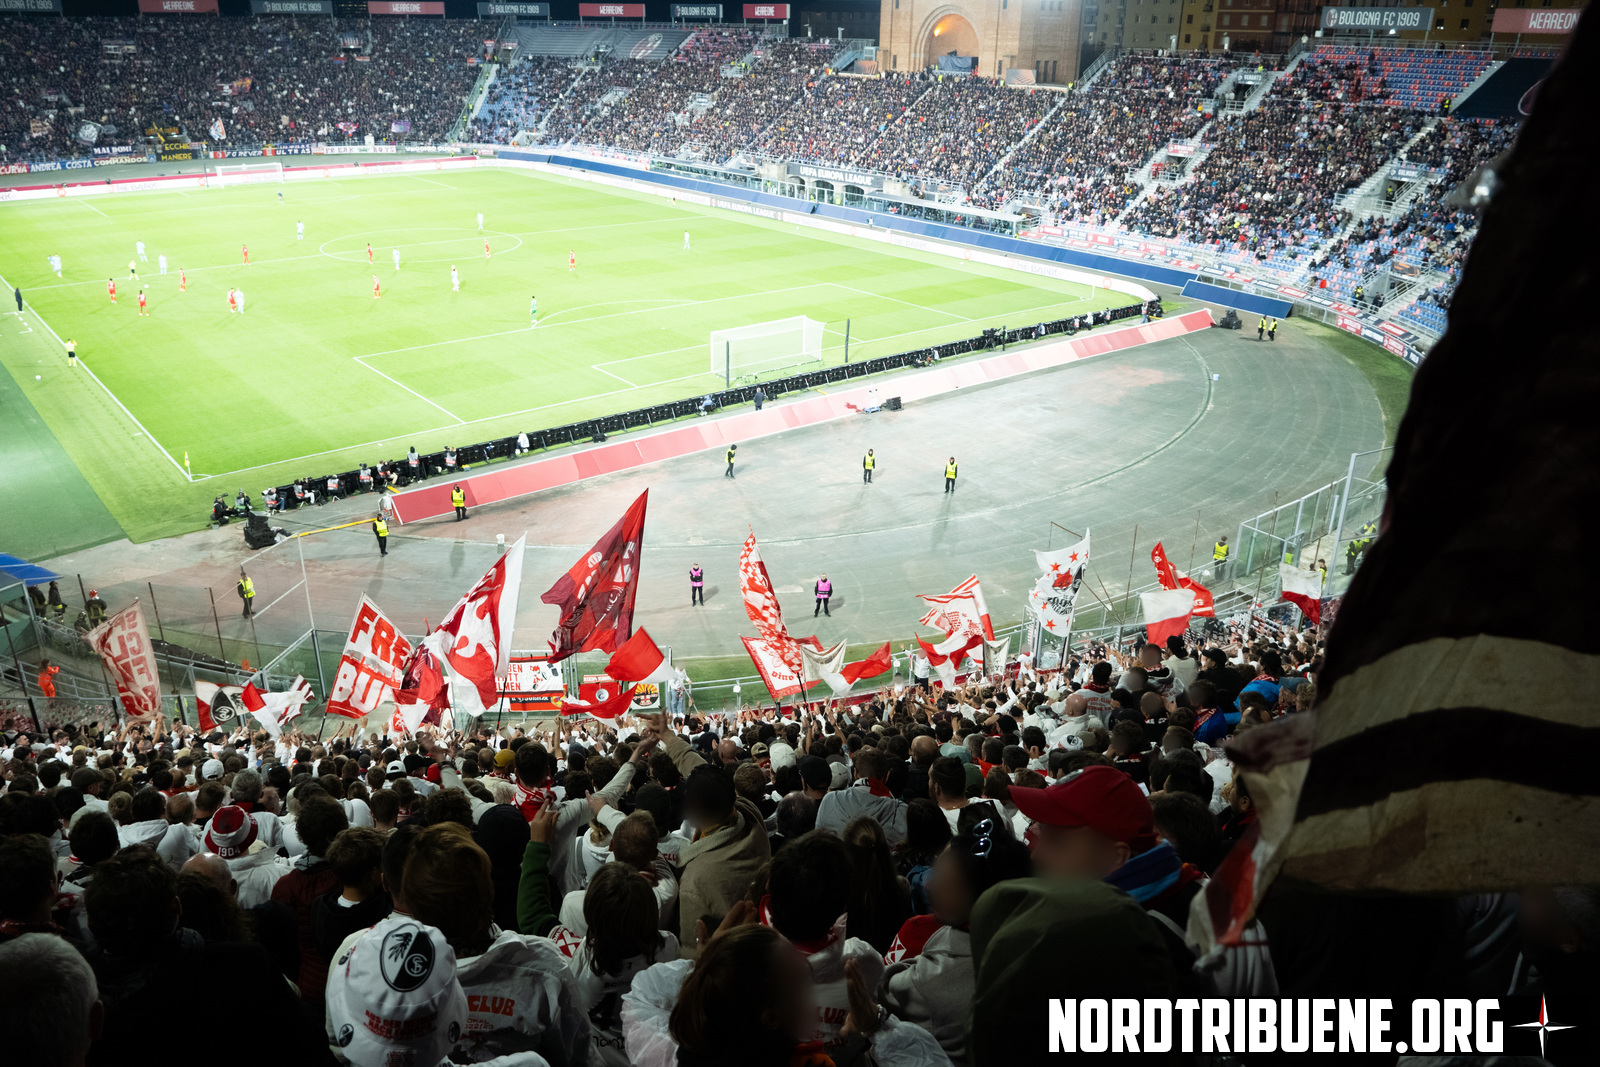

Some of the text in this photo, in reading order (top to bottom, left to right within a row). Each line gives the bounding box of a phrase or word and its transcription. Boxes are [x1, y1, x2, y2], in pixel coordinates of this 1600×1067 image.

[163, 1, 195, 10] WEAREONE
[272, 3, 322, 12] BOLOGNA FC 1909
[392, 3, 421, 12] WEAREONE
[495, 4, 540, 14] BOLOGNA FC 1909
[600, 5, 624, 15] WEAREONE
[680, 6, 717, 15] BOLOGNA FC 1909
[755, 6, 775, 16] WEAREONE
[1339, 10, 1421, 27] BOLOGNA FC 1909
[93, 147, 111, 155] MAI
[30, 162, 62, 172] ANDREA
[65, 160, 93, 170] COSTA
[94, 156, 148, 167] COMMANDOS
[799, 165, 872, 186] UEFA EUROPA LEAGUE
[717, 199, 776, 219] UEFA EUROPA LEAGUE
[218, 846, 241, 857] 1904
[467, 995, 515, 1017] CLUB
[365, 1009, 381, 1024] AUS
